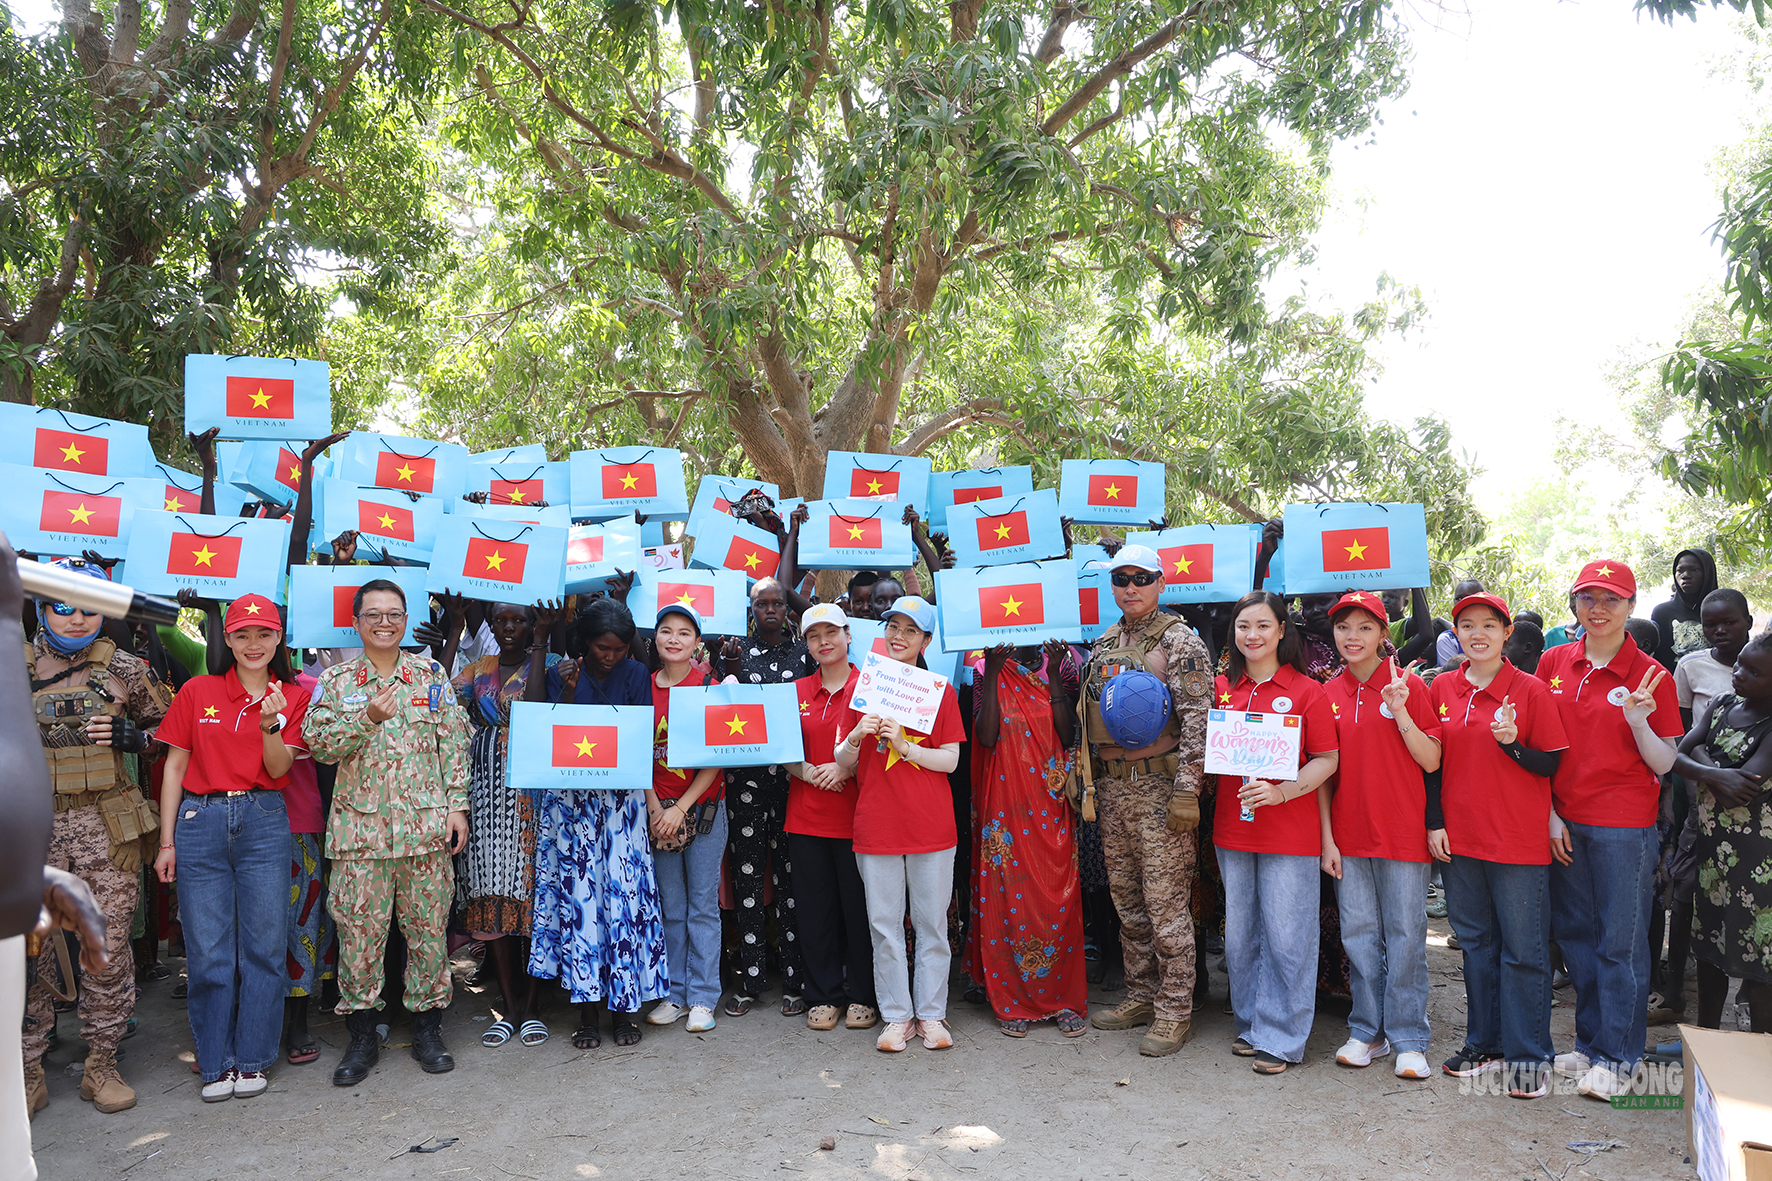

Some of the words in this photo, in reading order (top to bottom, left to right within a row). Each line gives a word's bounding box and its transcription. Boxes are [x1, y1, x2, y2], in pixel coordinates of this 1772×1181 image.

[876, 670, 896, 683] From
[898, 677, 930, 694] Vietnam
[876, 685, 895, 695] with
[895, 690, 915, 702] Love
[915, 696, 924, 704] &
[880, 698, 912, 713] Respect
[1210, 721, 1290, 757] Women's
[1250, 730, 1277, 738] HAPPY
[1229, 748, 1274, 772] Day
